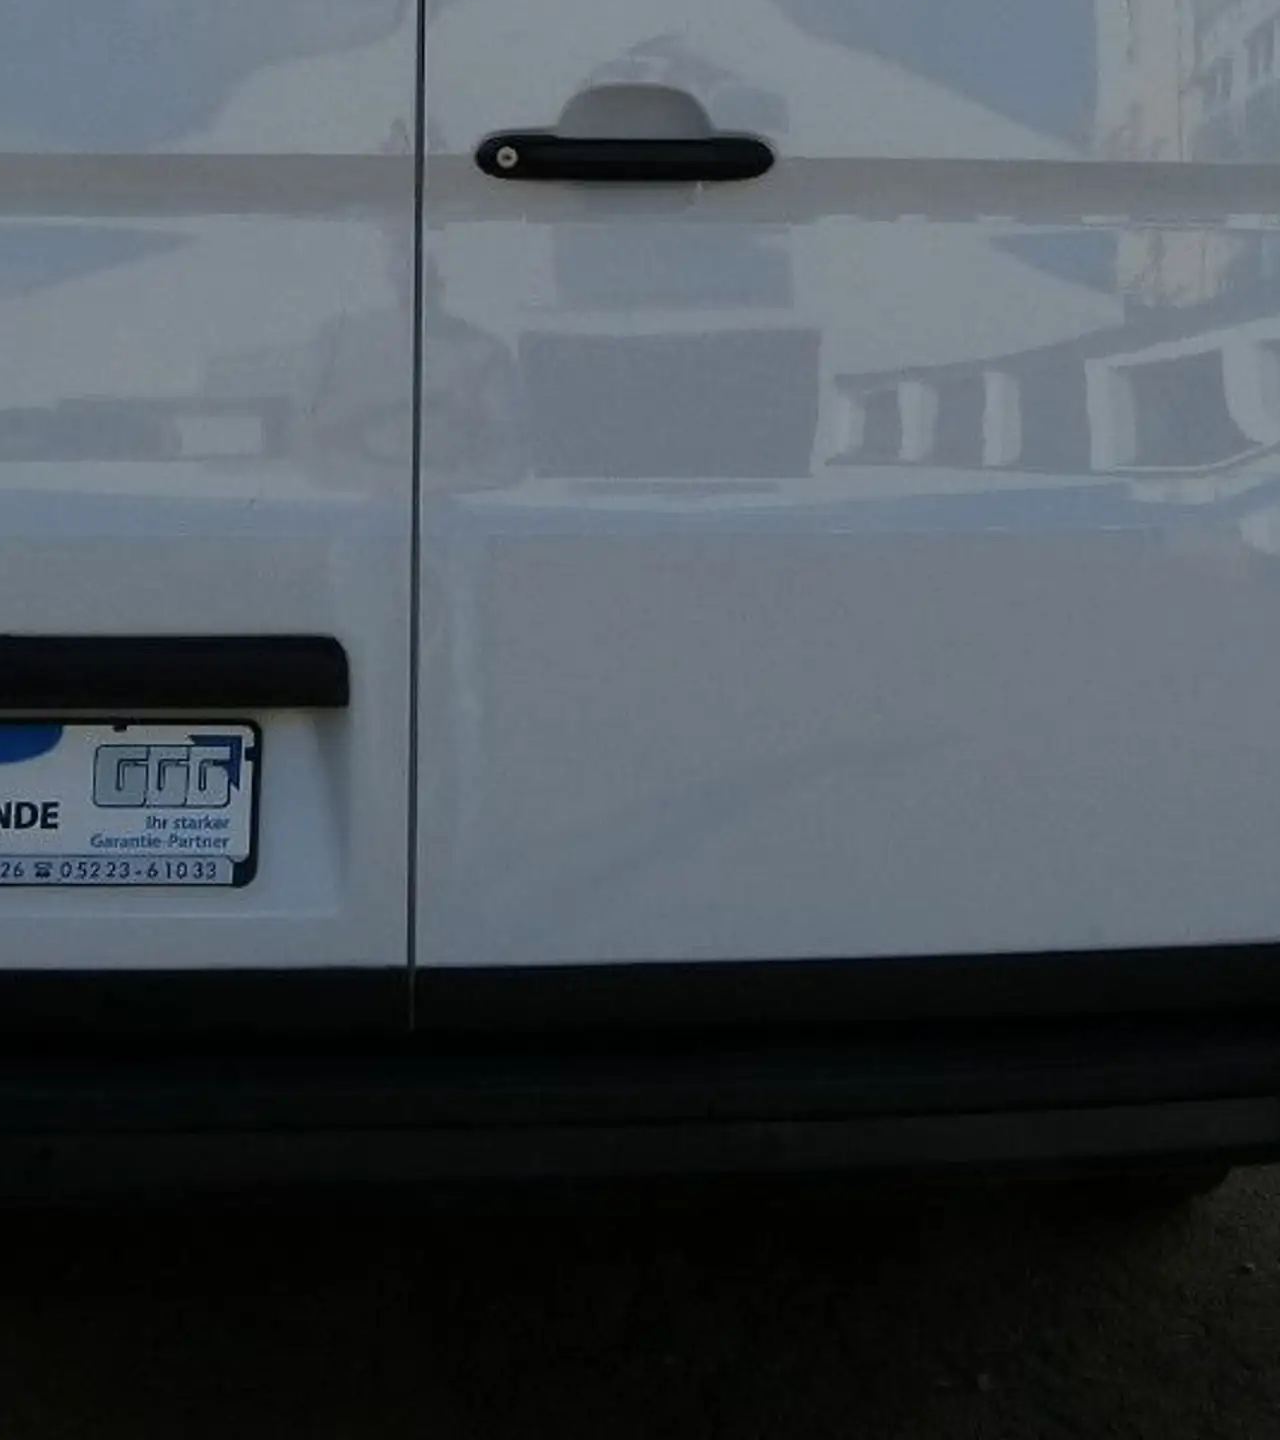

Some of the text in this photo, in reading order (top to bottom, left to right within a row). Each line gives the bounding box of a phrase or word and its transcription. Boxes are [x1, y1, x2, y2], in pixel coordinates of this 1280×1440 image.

[145, 815, 230, 830] Ihr starker
[90, 833, 230, 849] Garantie-Partner
[0, 862, 24, 879] 26
[60, 862, 217, 880] 05223-61033
